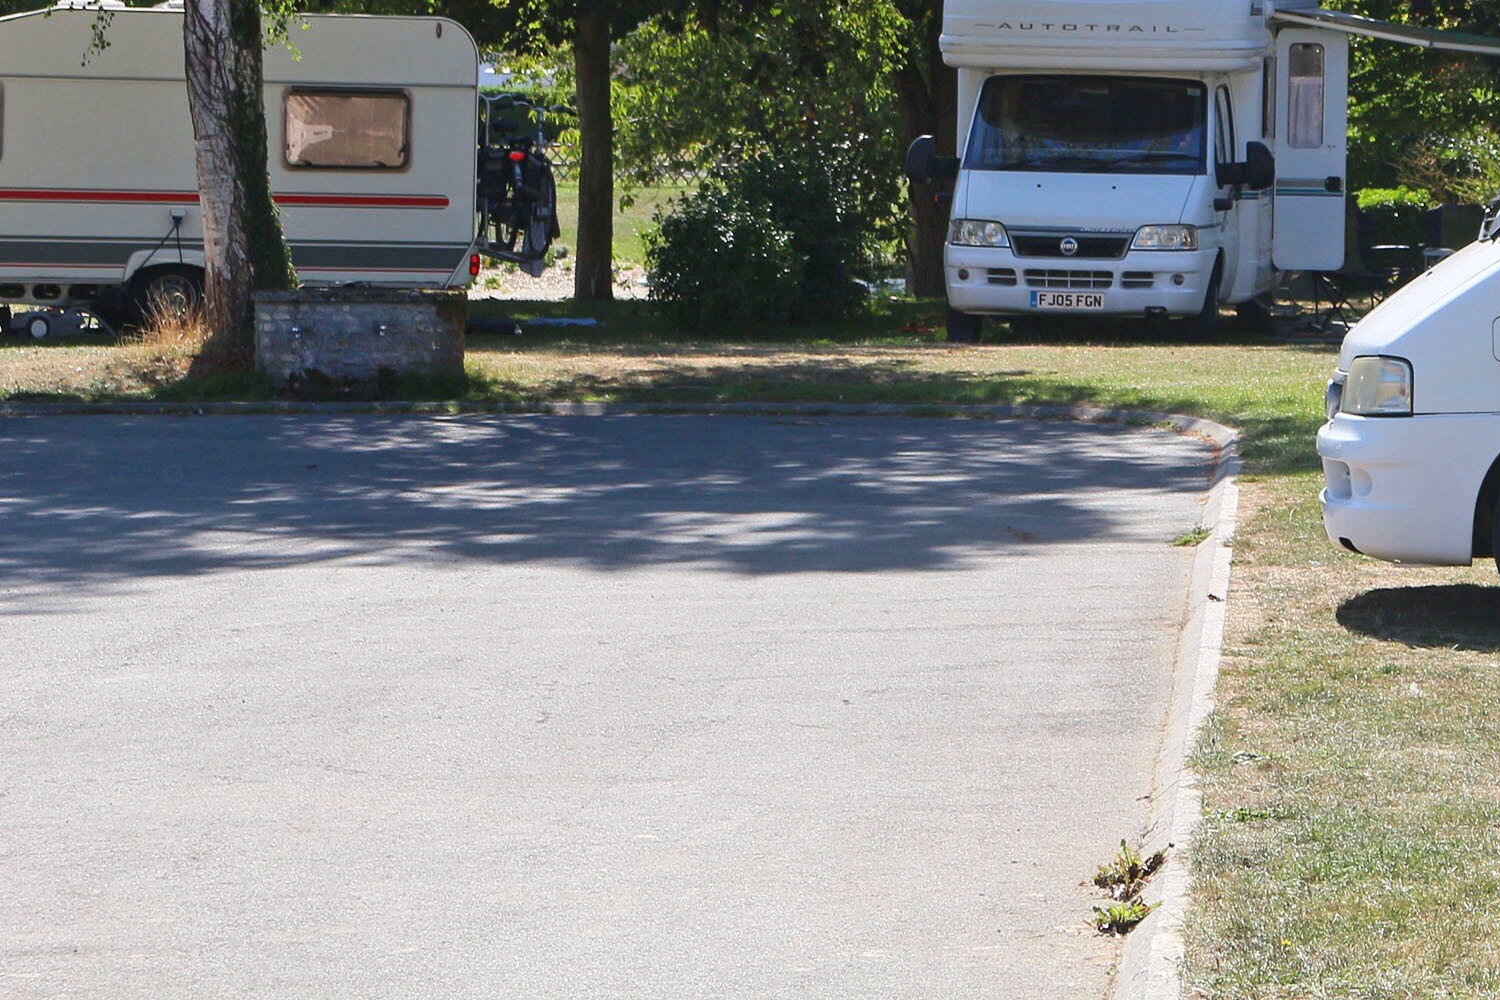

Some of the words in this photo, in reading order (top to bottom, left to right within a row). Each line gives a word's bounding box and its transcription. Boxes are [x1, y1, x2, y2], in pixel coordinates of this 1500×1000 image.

[998, 22, 1179, 32] AUTOTRAIL
[1038, 293, 1073, 307] FJ05
[1076, 294, 1102, 308] FGN
